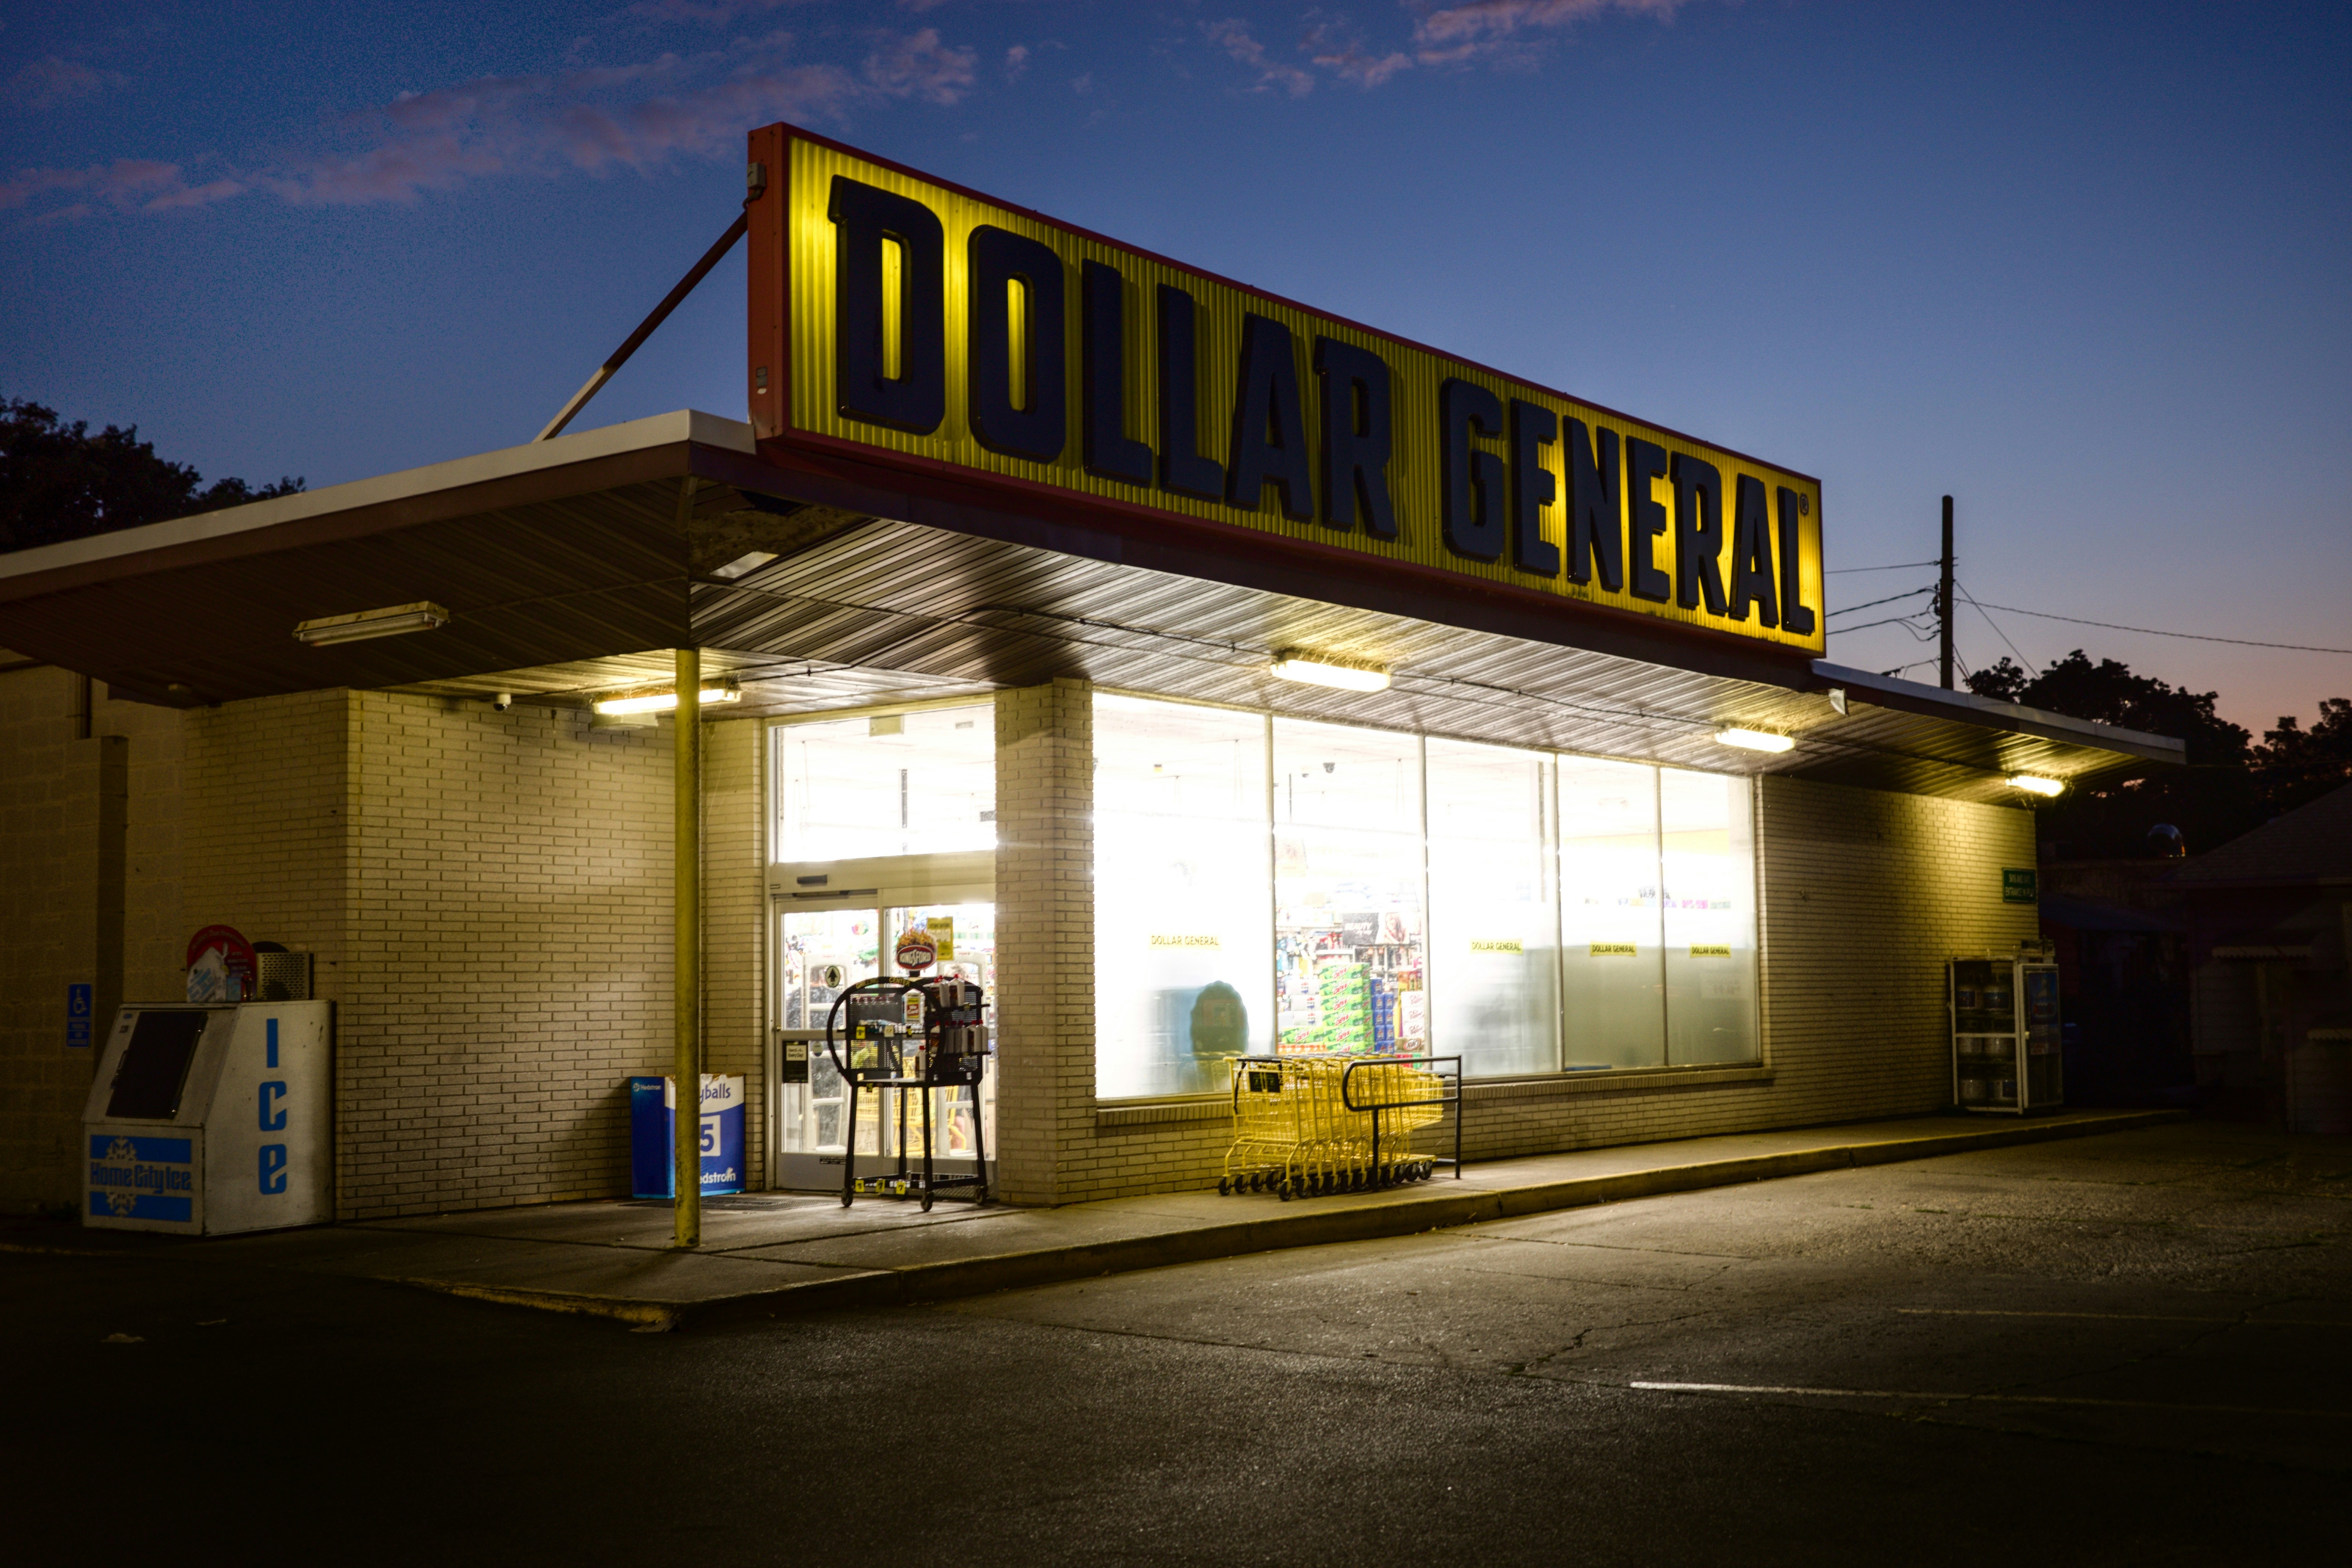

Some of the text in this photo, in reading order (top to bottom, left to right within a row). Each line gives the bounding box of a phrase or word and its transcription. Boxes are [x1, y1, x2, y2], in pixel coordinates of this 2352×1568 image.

[828, 174, 1815, 635] DOLLAR GENERAL
[1151, 935, 1219, 945] DOLLAR GENERAL
[1472, 942, 1521, 951] DOLLAR GENERAL
[1710, 946, 1730, 955] GENERAL
[899, 949, 931, 967] KINGSFORD
[889, 977, 910, 987] CENTER
[90, 1162, 191, 1194] Home City Ice
[700, 1172, 736, 1184] edstrom
